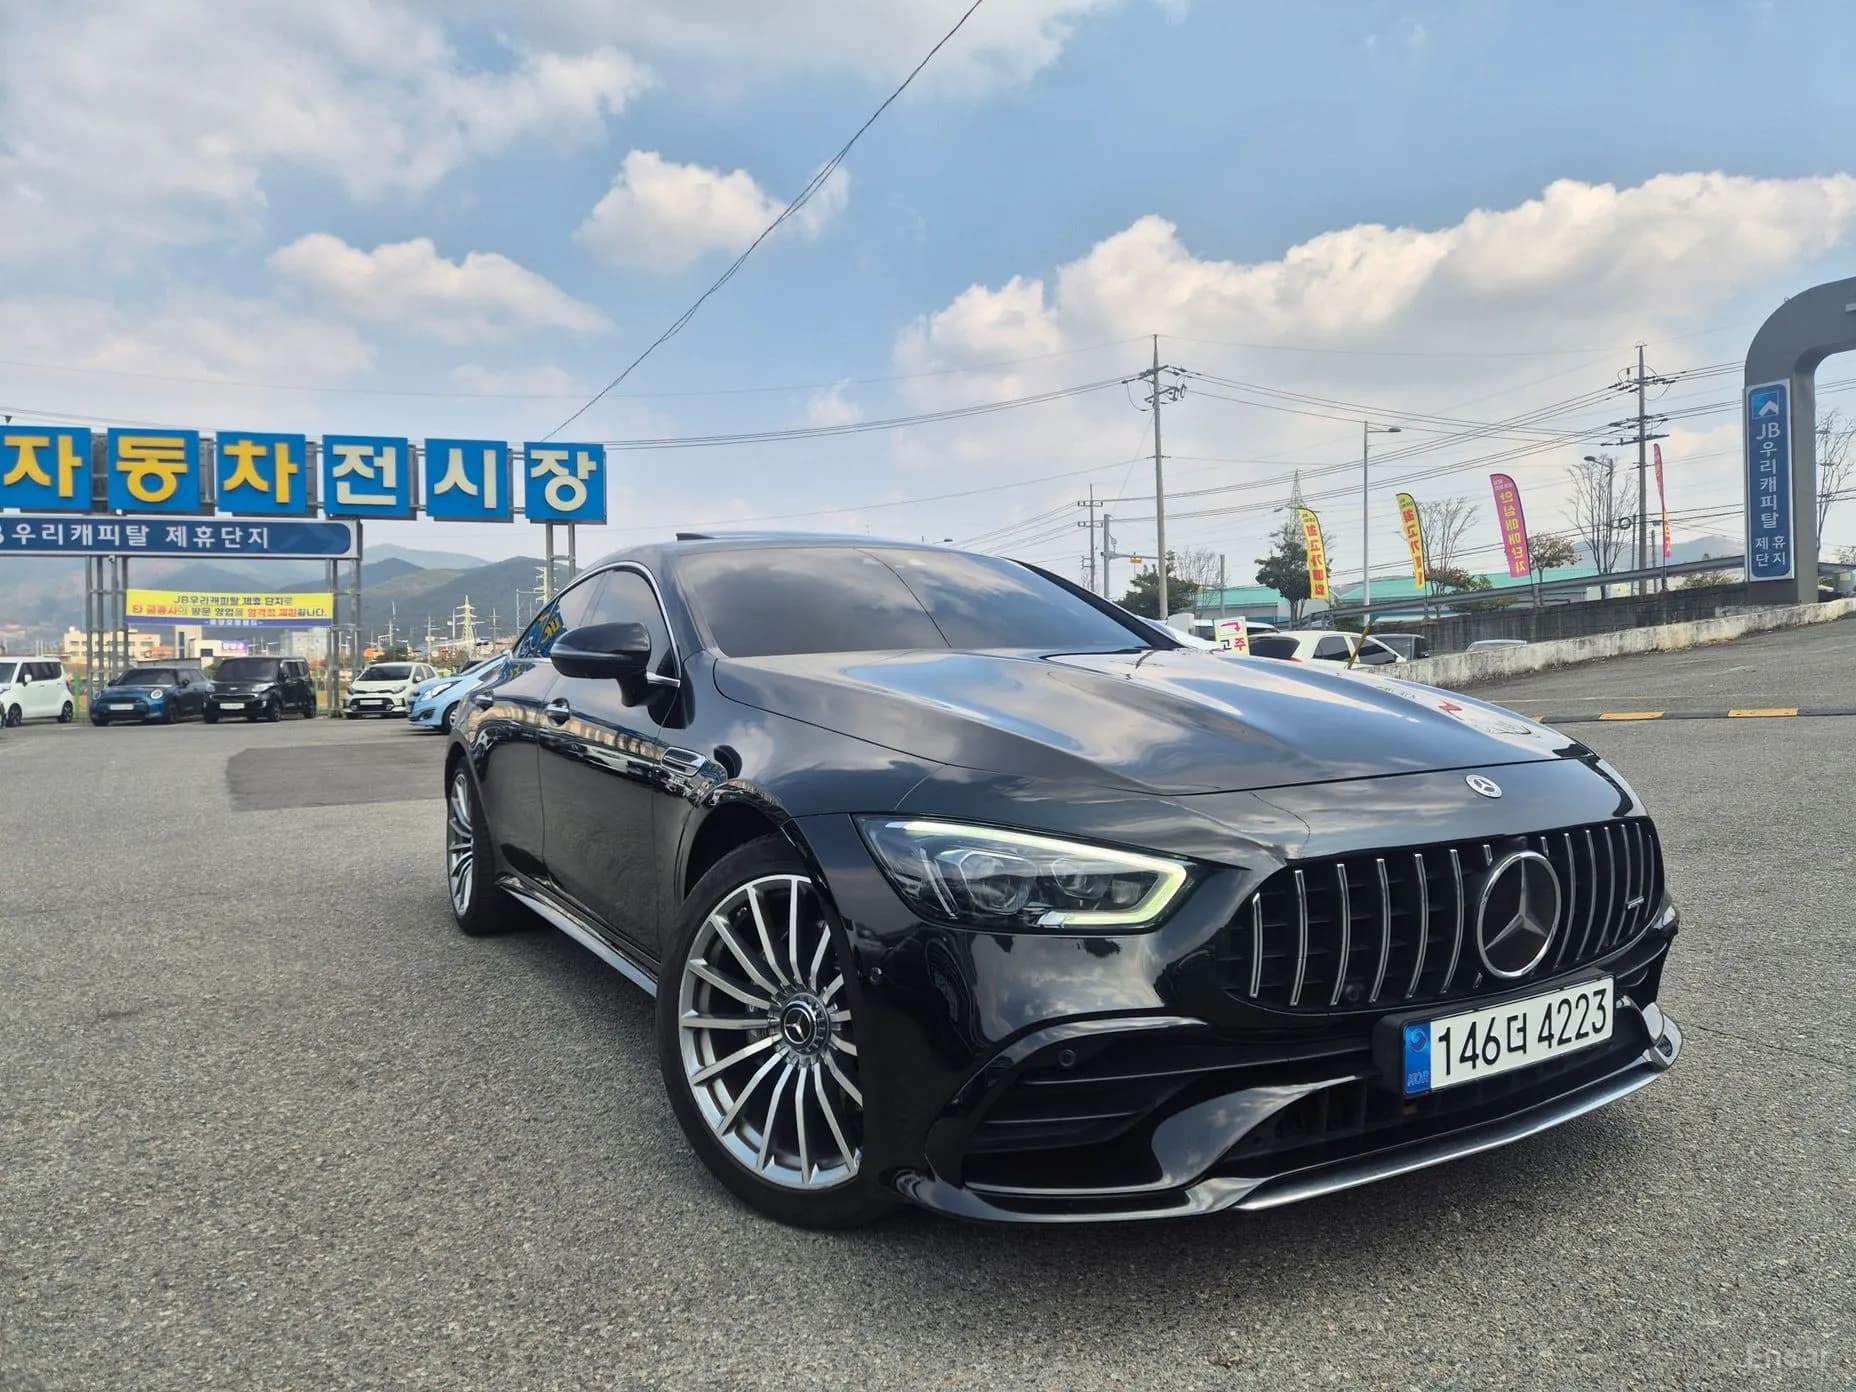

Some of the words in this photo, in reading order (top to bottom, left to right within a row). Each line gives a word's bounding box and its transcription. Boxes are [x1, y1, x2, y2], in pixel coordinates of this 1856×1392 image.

[0, 522, 150, 548] 우리캐피탈
[165, 525, 269, 549] 제휴단지
[174, 595, 239, 606] JB우리캐피탈
[1438, 1012, 1527, 1076] 146더
[1538, 988, 1607, 1048] 4223
